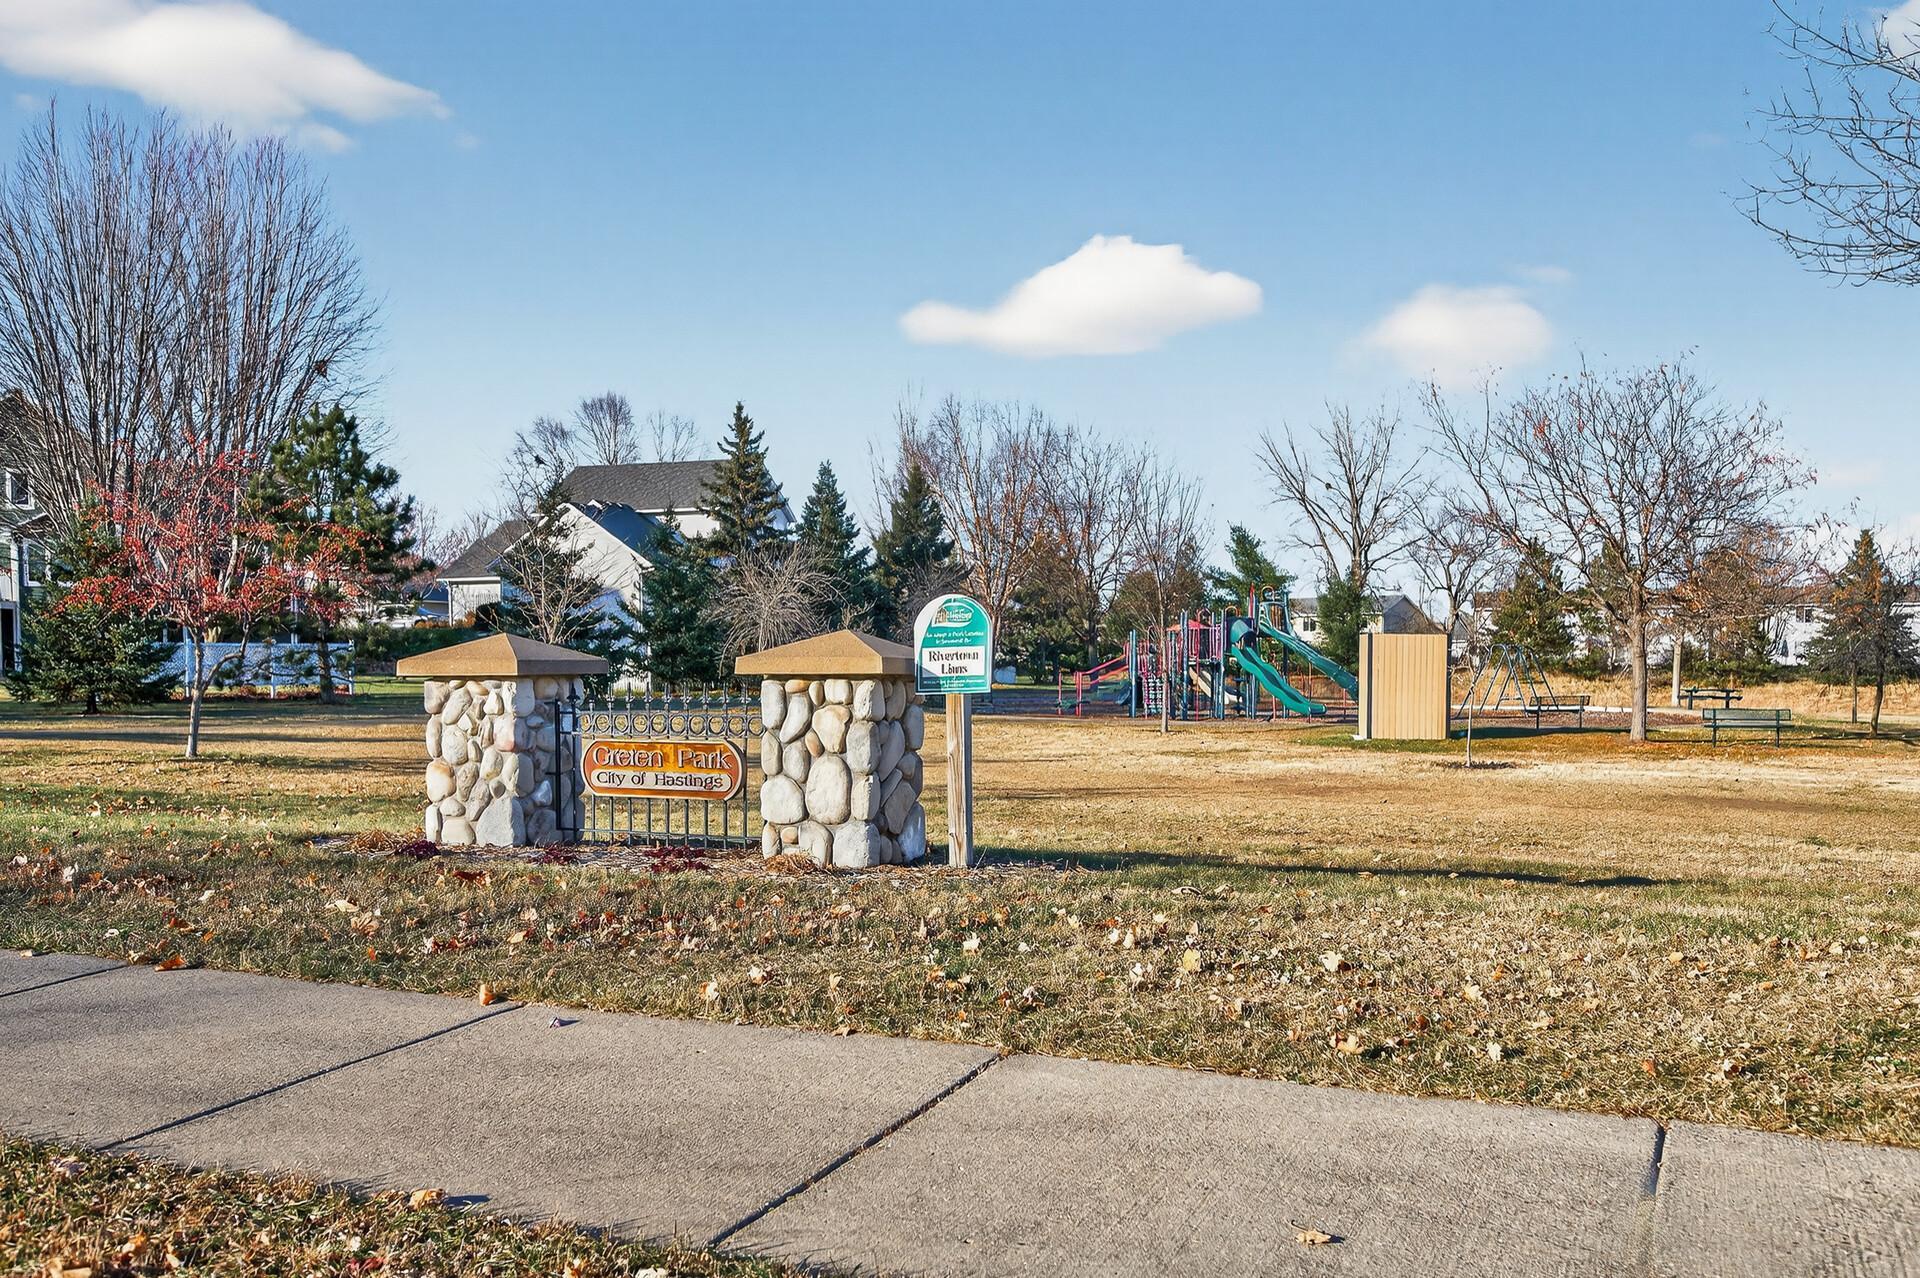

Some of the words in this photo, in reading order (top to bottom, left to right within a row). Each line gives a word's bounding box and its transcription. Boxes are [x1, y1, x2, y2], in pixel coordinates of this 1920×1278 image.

[677, 748, 732, 769] Park
[596, 771, 626, 786] City
[631, 771, 646, 786] of
[654, 773, 723, 790] Hastings
